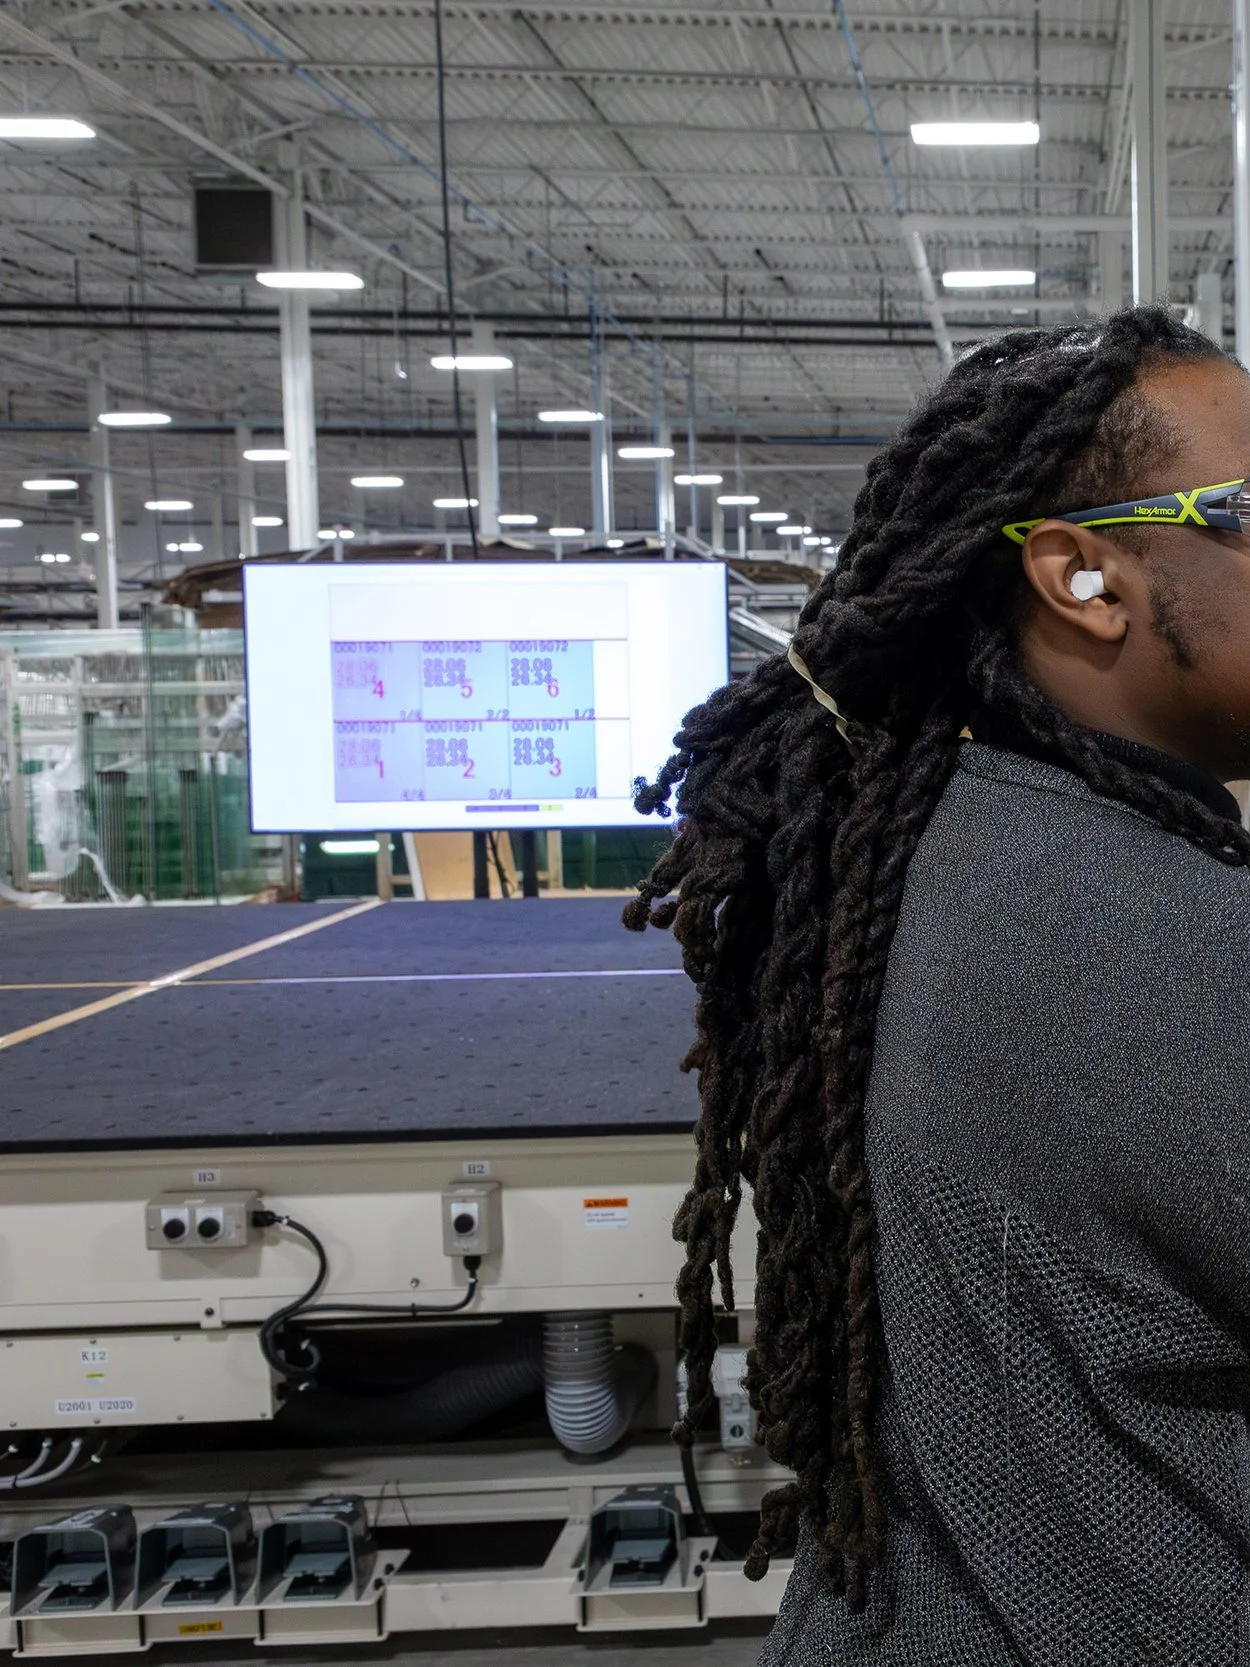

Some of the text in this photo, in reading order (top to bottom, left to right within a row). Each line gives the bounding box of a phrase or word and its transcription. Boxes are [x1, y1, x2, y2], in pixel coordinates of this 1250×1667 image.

[1134, 506, 1176, 517] HexArmor
[468, 1164, 484, 1175] H2
[198, 1172, 215, 1183] H3
[81, 1351, 106, 1361] K12
